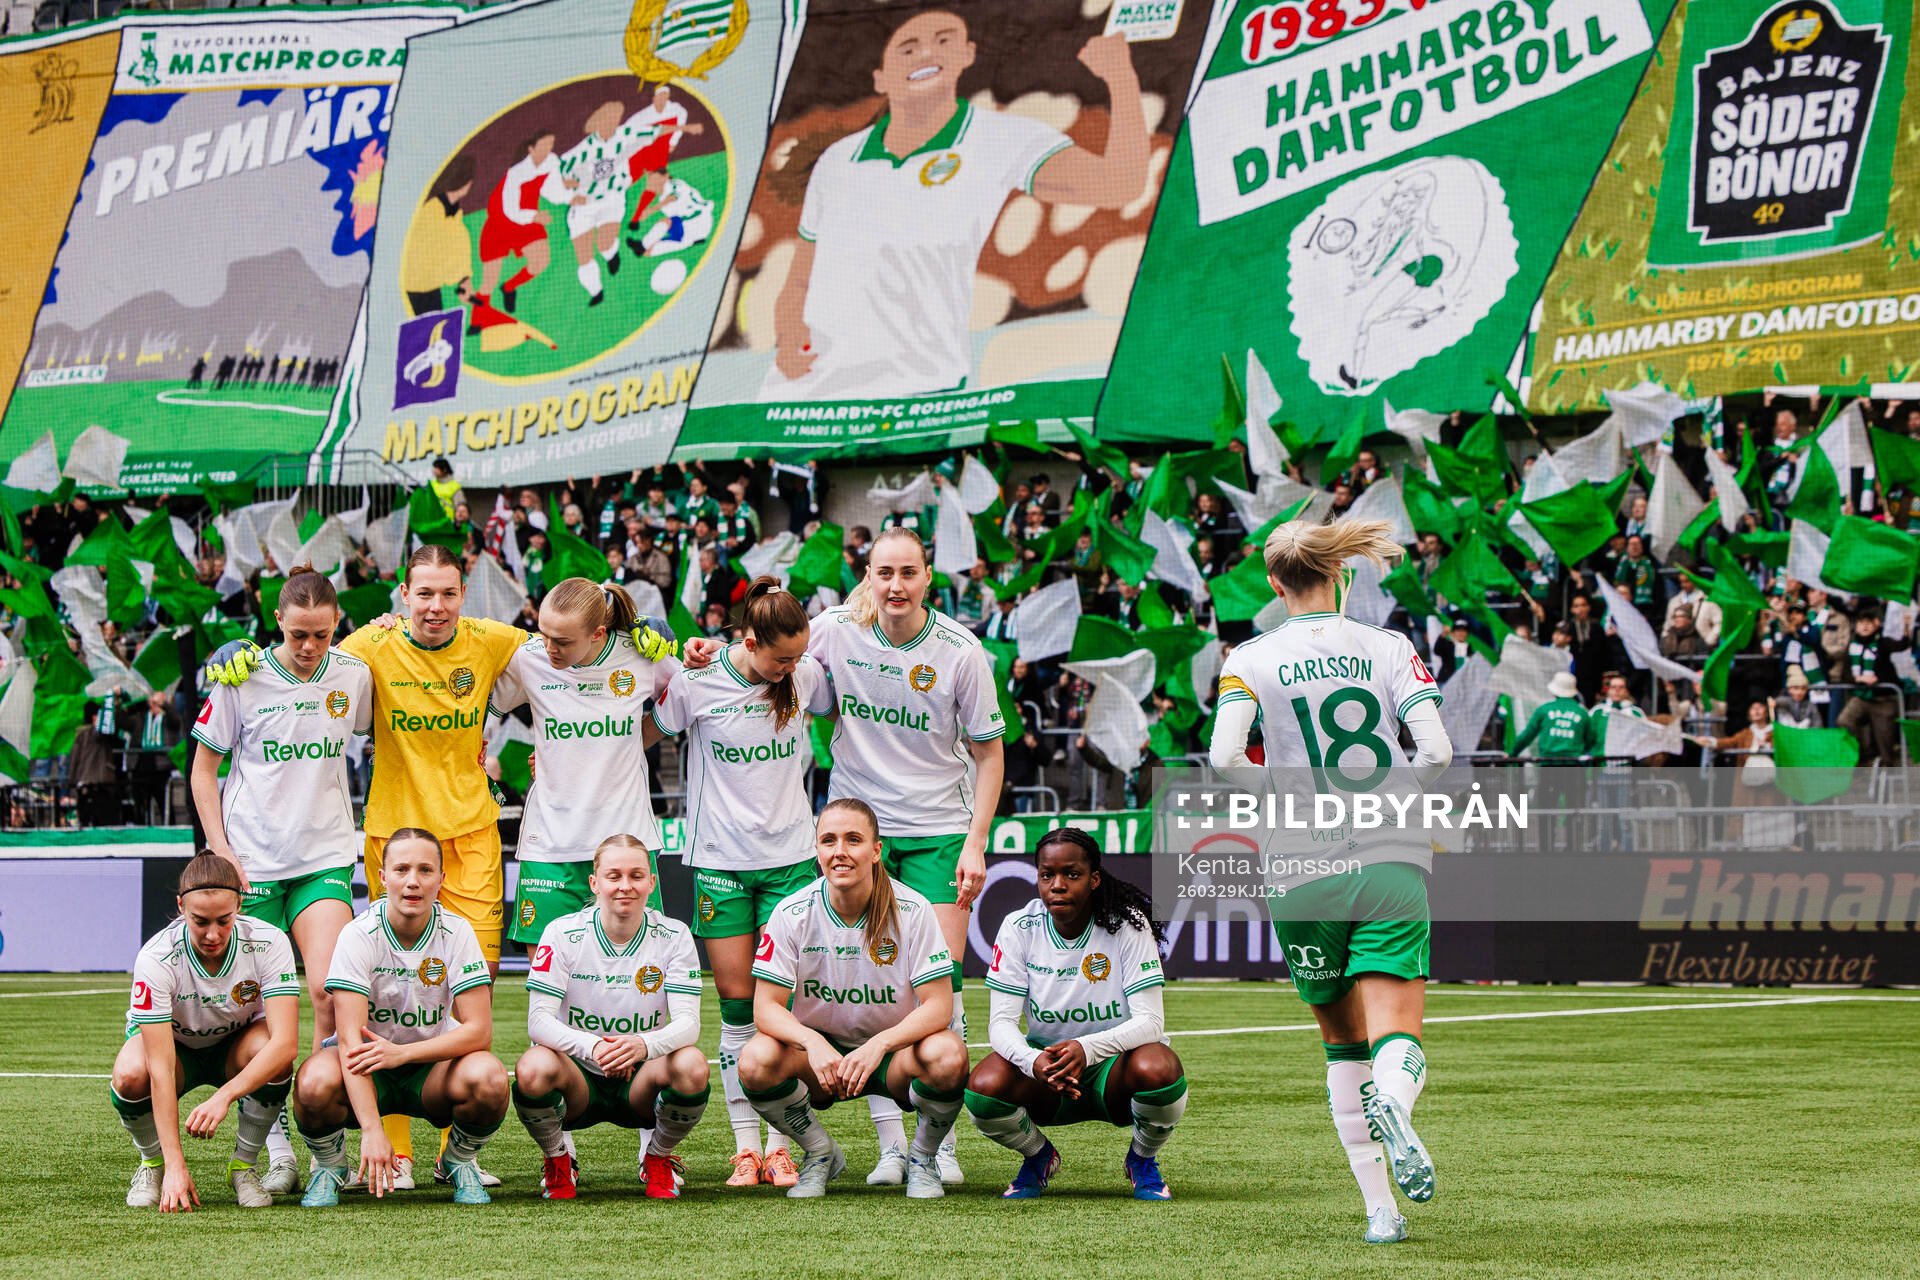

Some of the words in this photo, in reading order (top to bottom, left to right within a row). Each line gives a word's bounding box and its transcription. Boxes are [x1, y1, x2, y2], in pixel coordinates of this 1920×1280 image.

[1266, 0, 1553, 127] HAMMARBY
[1716, 54, 1862, 99] BAJENZ
[1233, 16, 1617, 195] DAMFOTBOLL
[1710, 87, 1861, 152] SÖDER
[96, 85, 398, 217] PREMIÄR!
[1706, 141, 1848, 204] BÖNOR
[1553, 312, 1738, 363] HAMMARBY
[908, 389, 1017, 416] ROSENGÅRD
[1279, 655, 1372, 687] CARLSSON
[391, 706, 480, 732] Revolut
[545, 715, 634, 740] Revolut
[841, 694, 930, 732] Revolut
[263, 736, 344, 762] Revolut
[712, 736, 797, 763] Revolut
[1291, 687, 1392, 796] 18
[1639, 941, 1878, 981] Flexibussitet
[804, 979, 896, 1005] Revolut
[568, 1006, 663, 1033] Revolut
[1030, 999, 1122, 1025] Revolut
